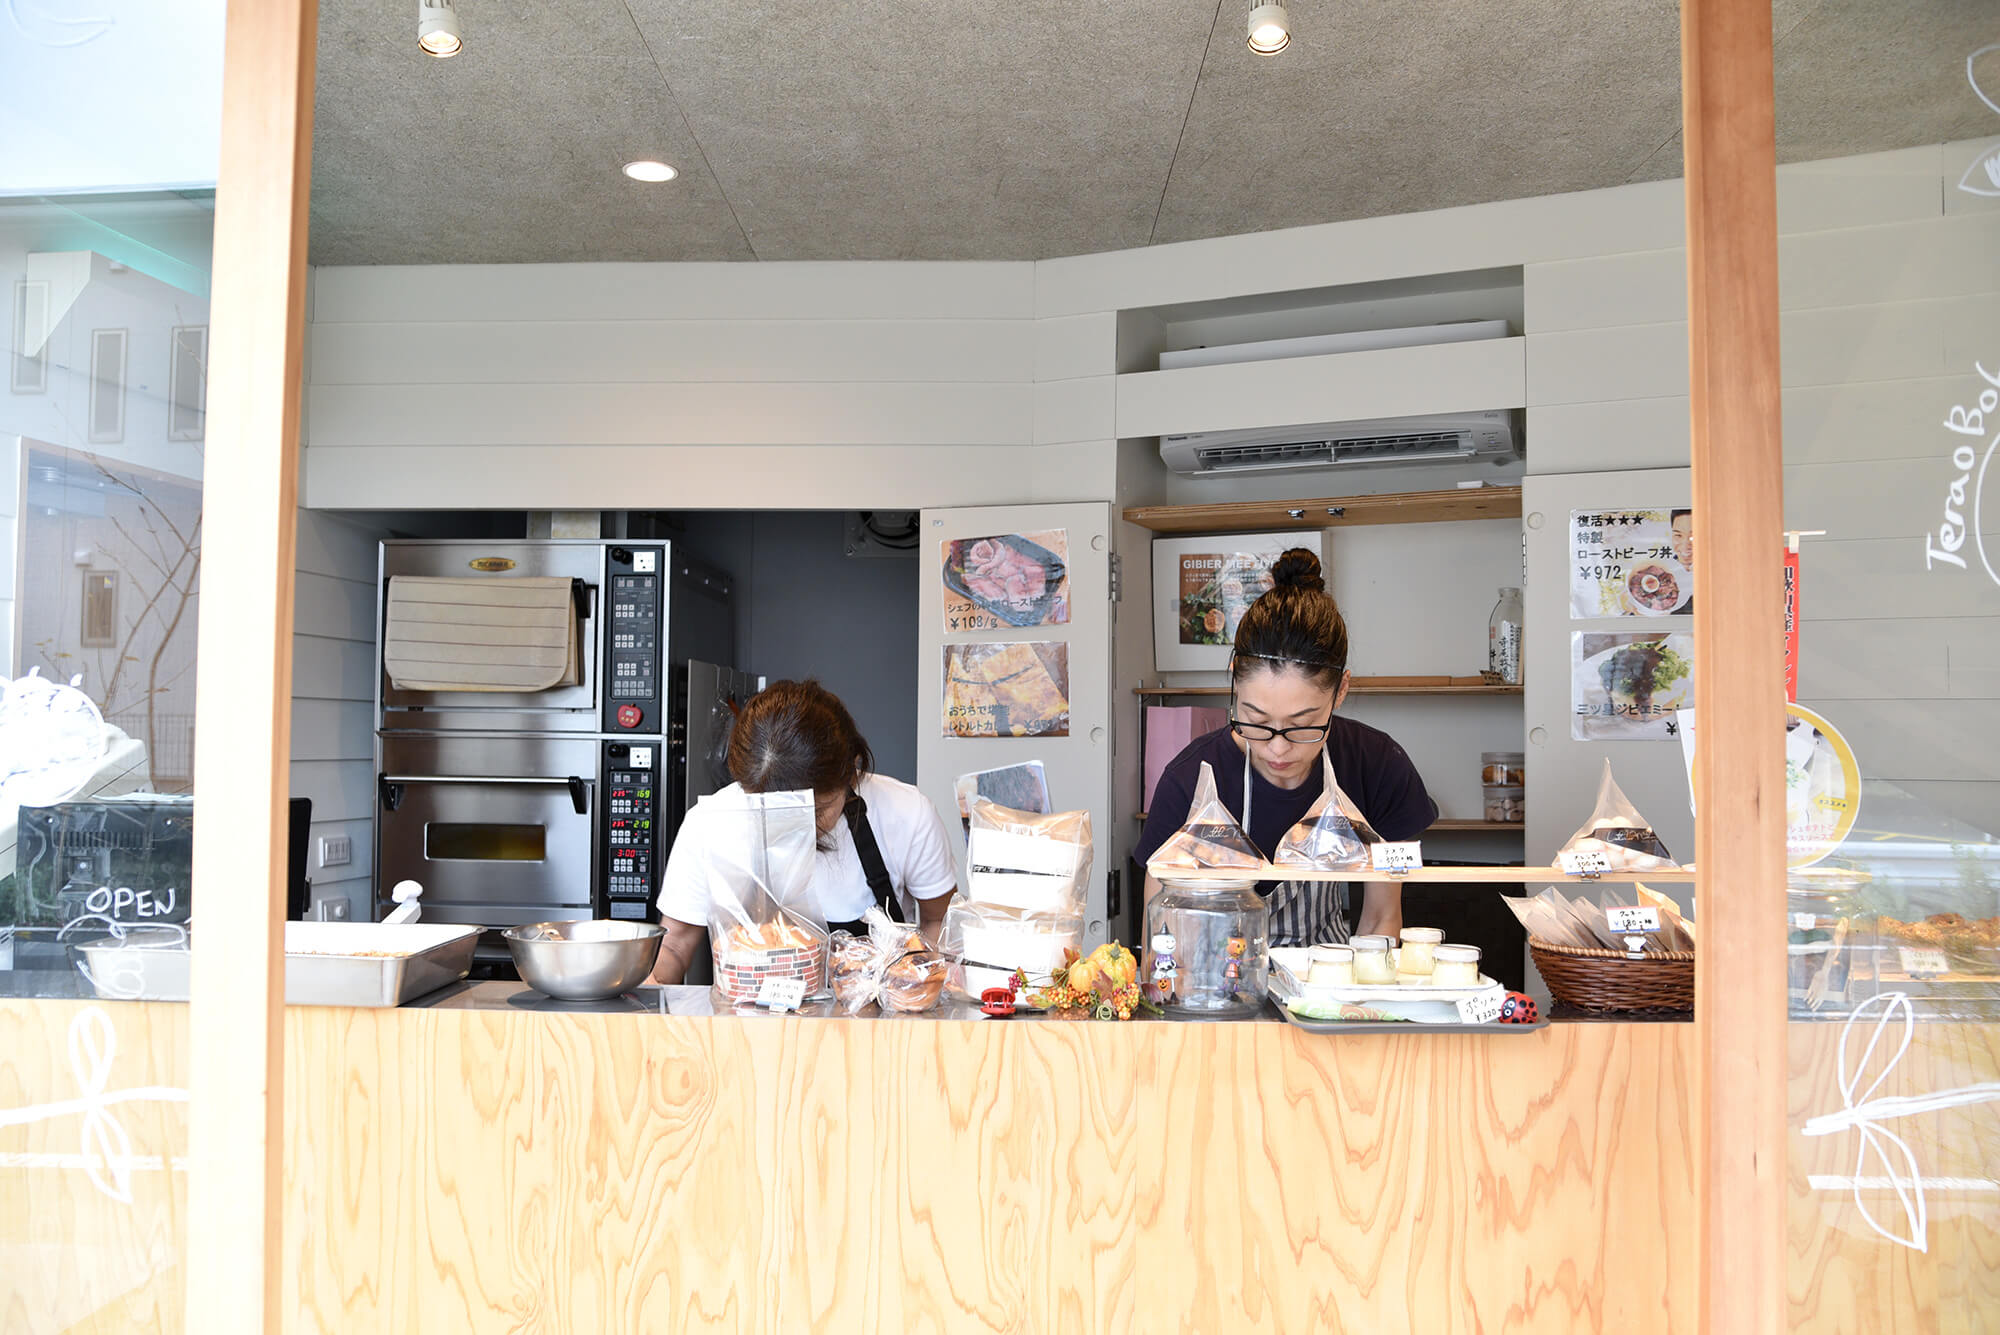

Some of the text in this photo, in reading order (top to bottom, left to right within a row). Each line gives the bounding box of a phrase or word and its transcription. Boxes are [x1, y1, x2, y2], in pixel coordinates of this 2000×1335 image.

[1926, 447, 1975, 571] Terao
[1577, 531, 1604, 544] 特製
[1183, 560, 1222, 569] GIBIER
[1580, 565, 1622, 580] ¥972
[636, 789, 651, 799] 169
[632, 819, 651, 830] 219
[617, 848, 636, 858] 3:00
[85, 886, 176, 918] OPEN
